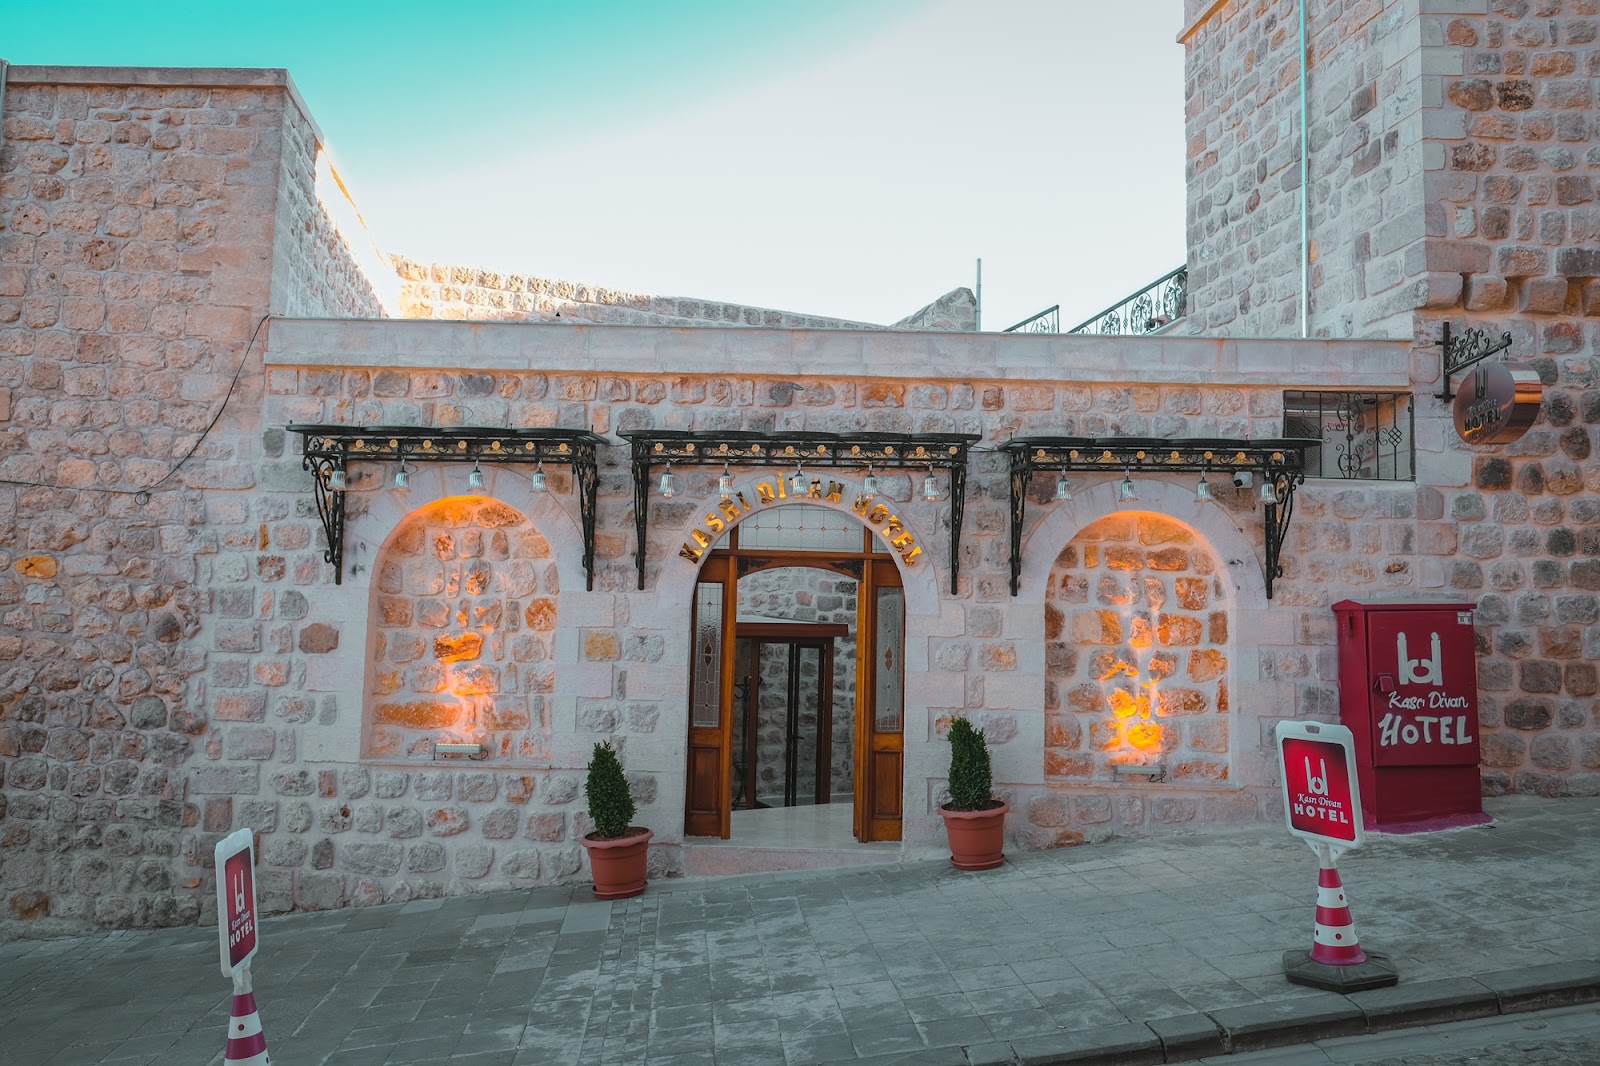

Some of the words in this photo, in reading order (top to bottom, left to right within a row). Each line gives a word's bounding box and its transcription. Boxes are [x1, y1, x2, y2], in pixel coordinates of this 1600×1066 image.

[1464, 408, 1502, 432] HOTEL
[756, 471, 845, 504] DİAN
[851, 492, 922, 567] HOTEL
[1428, 691, 1468, 708] Divan
[1318, 796, 1342, 808] Divan
[1294, 803, 1348, 824] HOTEL
[230, 919, 253, 947] HOTEL
